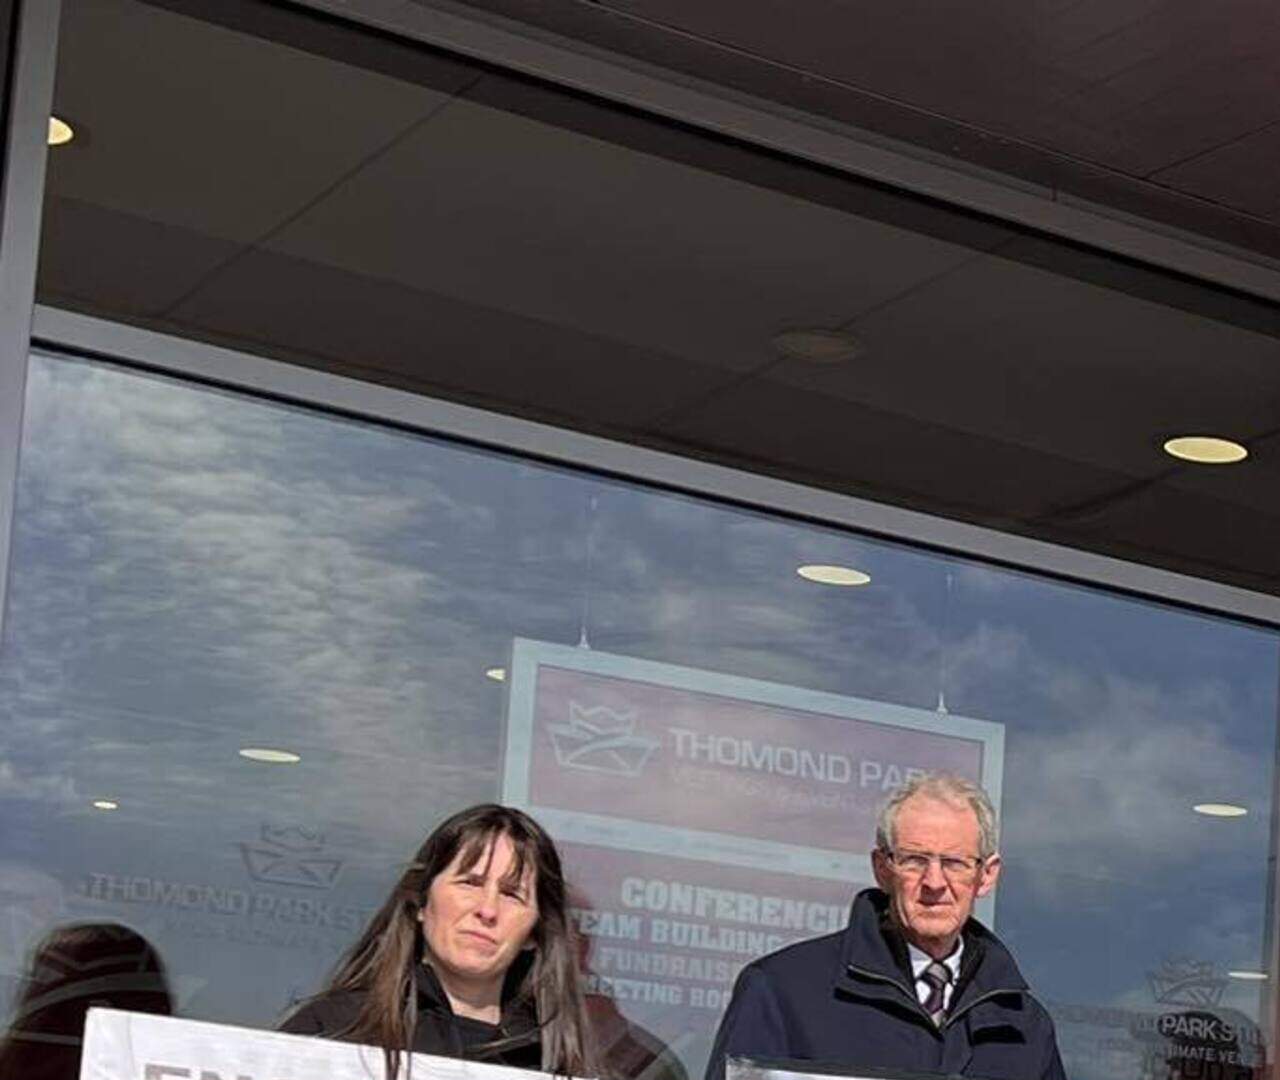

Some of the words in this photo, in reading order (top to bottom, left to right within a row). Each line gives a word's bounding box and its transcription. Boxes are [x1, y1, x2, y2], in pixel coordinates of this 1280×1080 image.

[667, 727, 851, 784] THOMOND
[861, 760, 928, 792] PAR
[620, 876, 845, 932] CONFERENCI
[599, 947, 736, 982] FUNDRAIS
[1161, 1013, 1217, 1043] PARK
